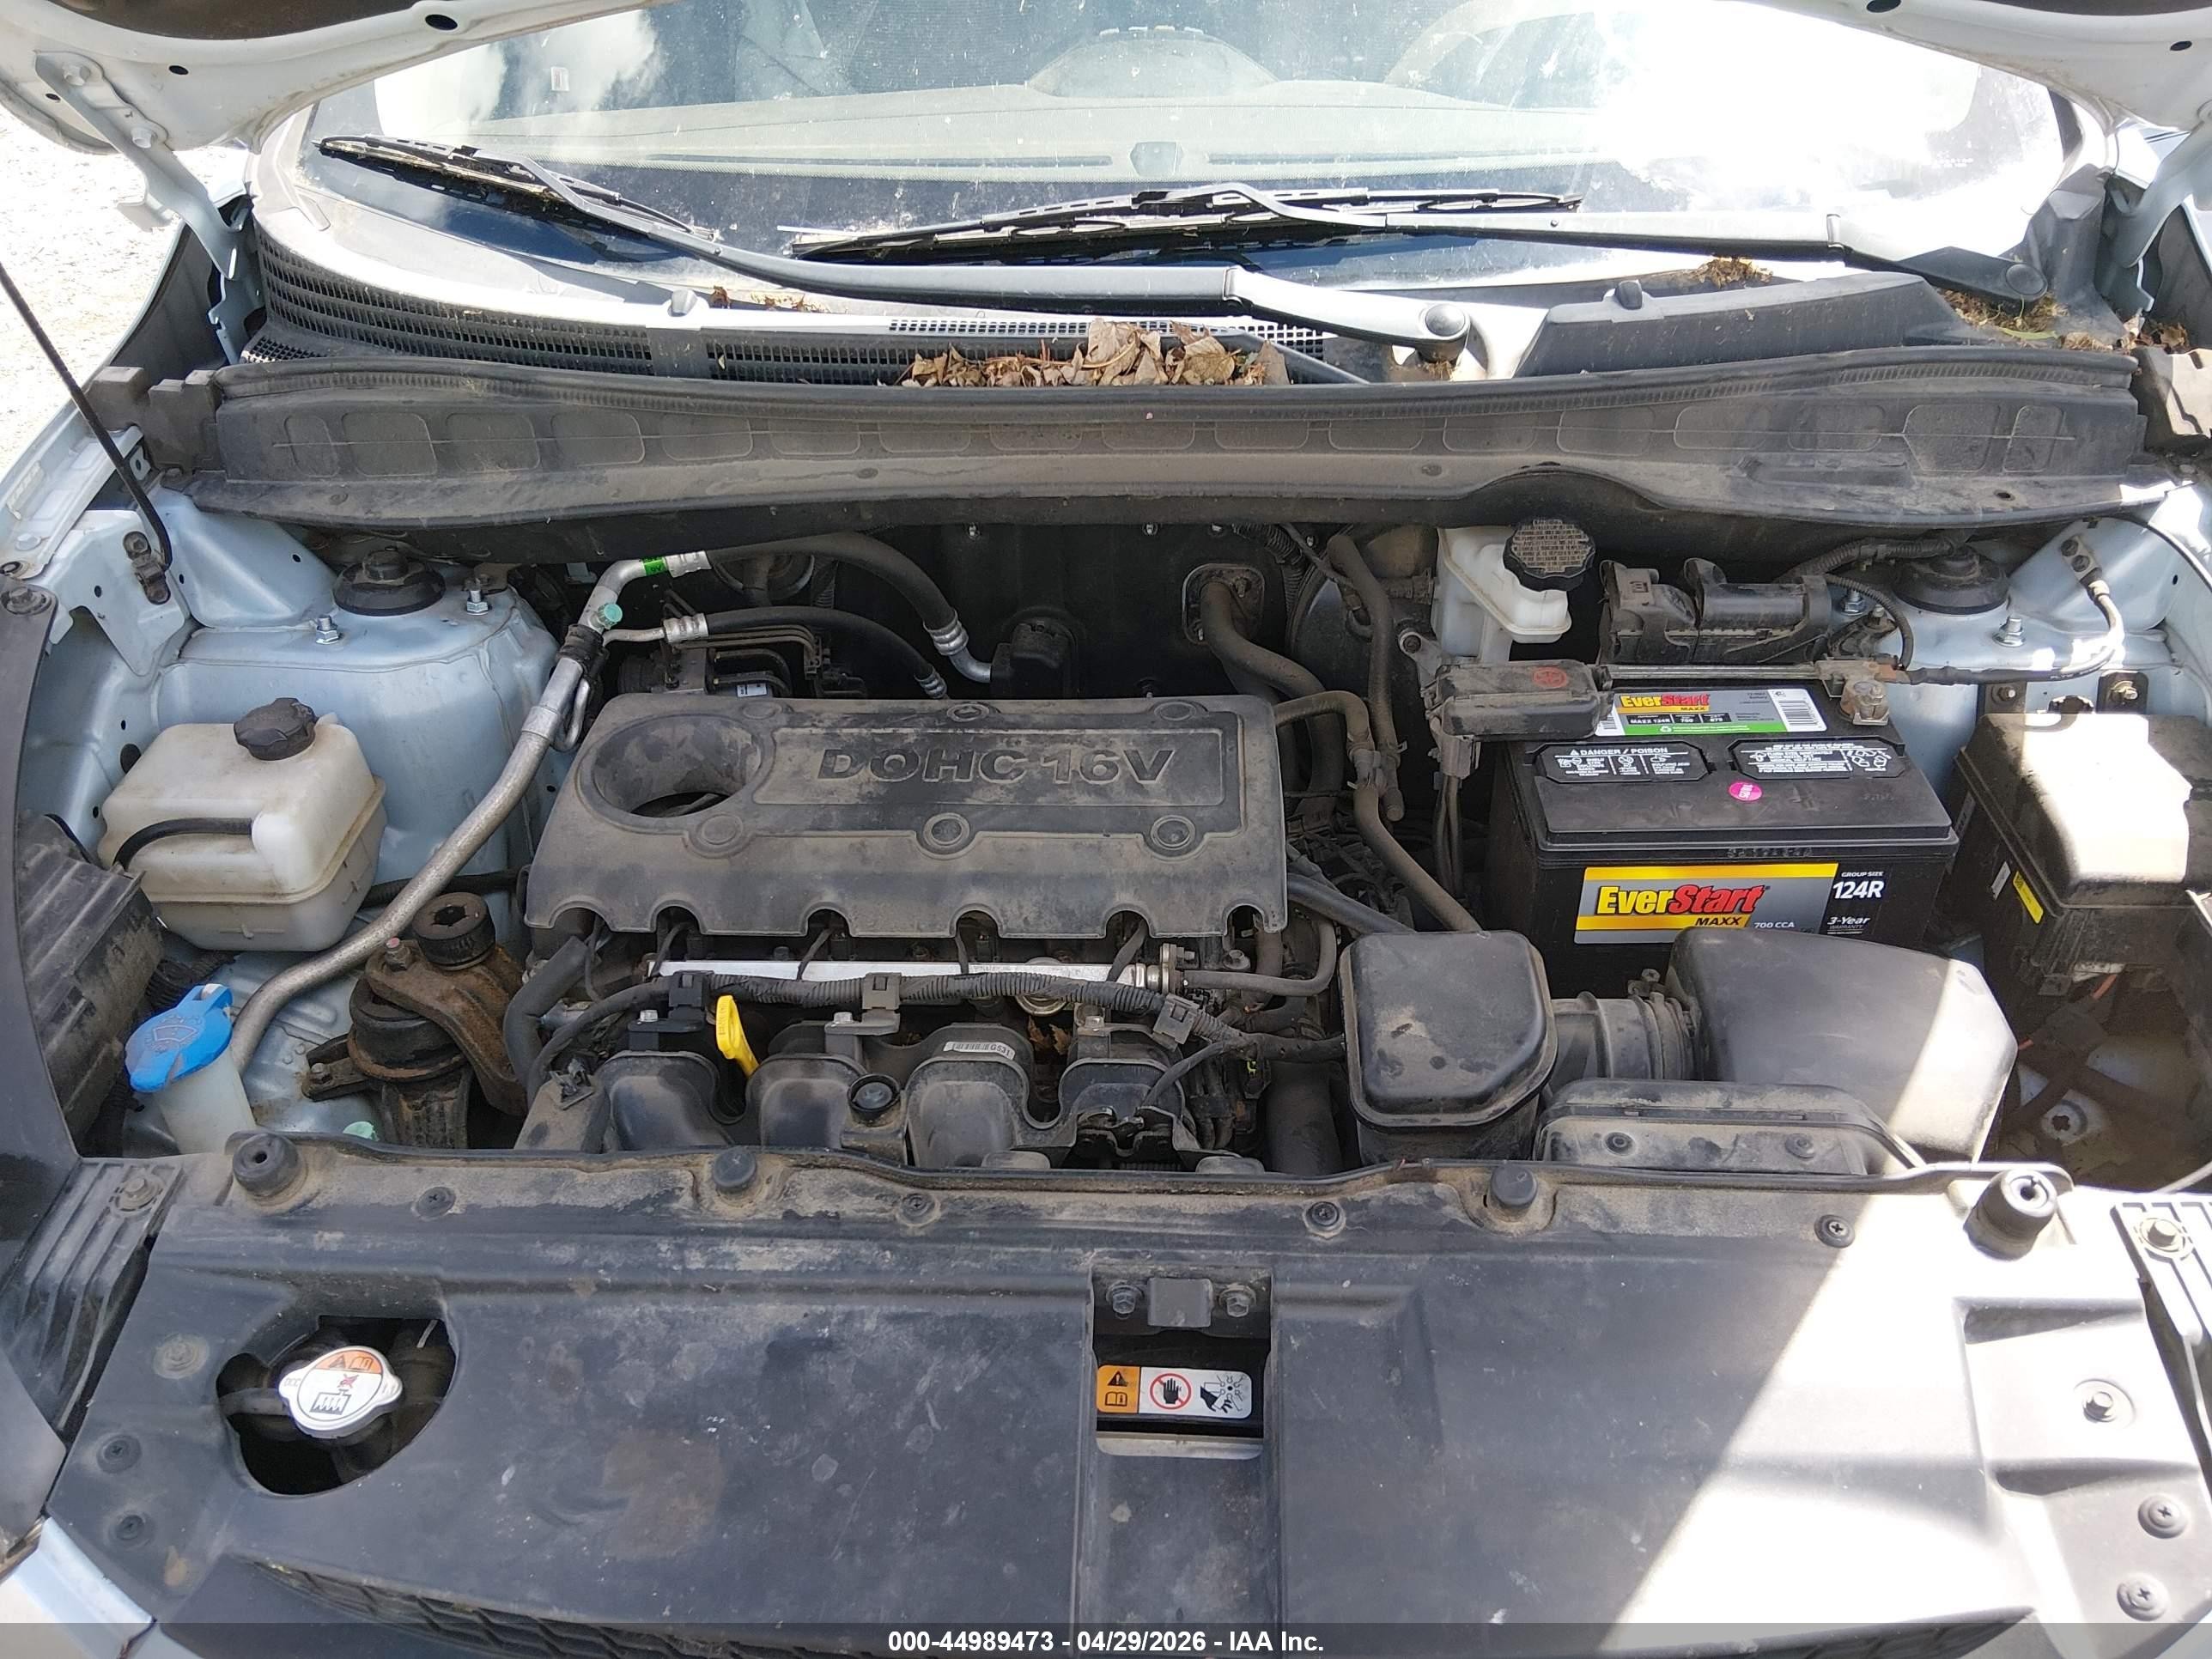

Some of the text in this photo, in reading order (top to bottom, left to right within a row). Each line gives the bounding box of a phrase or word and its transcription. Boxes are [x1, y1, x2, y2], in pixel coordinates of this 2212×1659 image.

[1620, 693, 1710, 708] EverStart
[817, 748, 1176, 784] DOHC 16V
[1832, 880, 1885, 899] 124R
[1596, 884, 1765, 915] EverStart
[1695, 917, 1742, 926] MAXX
[1827, 916, 1871, 925] 3-Year
